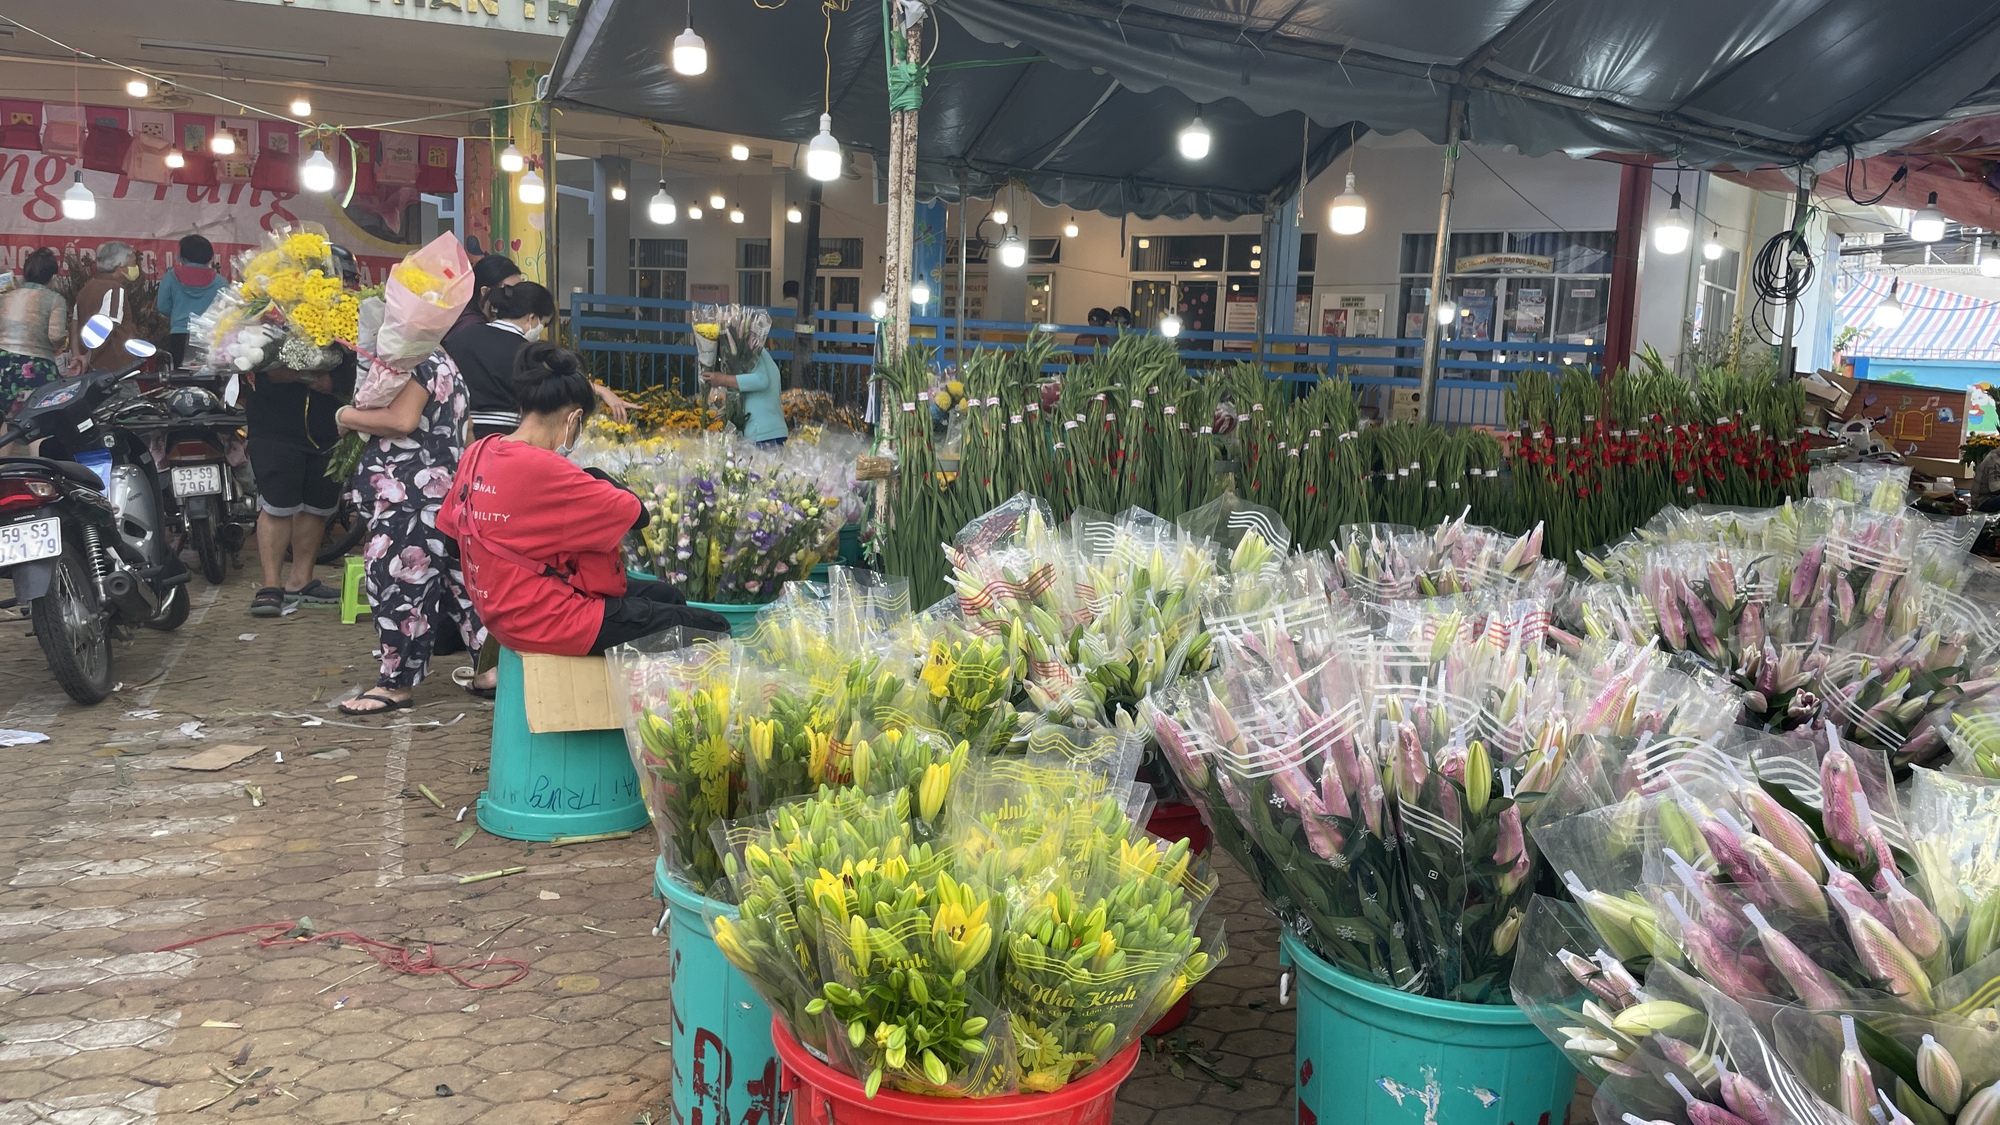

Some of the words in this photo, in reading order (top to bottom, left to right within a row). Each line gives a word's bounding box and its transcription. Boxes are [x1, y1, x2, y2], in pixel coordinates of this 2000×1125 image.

[2, 522, 49, 544] 59-S3
[1028, 982, 1078, 1008] Nhà
[1081, 984, 1138, 1009] Kính
